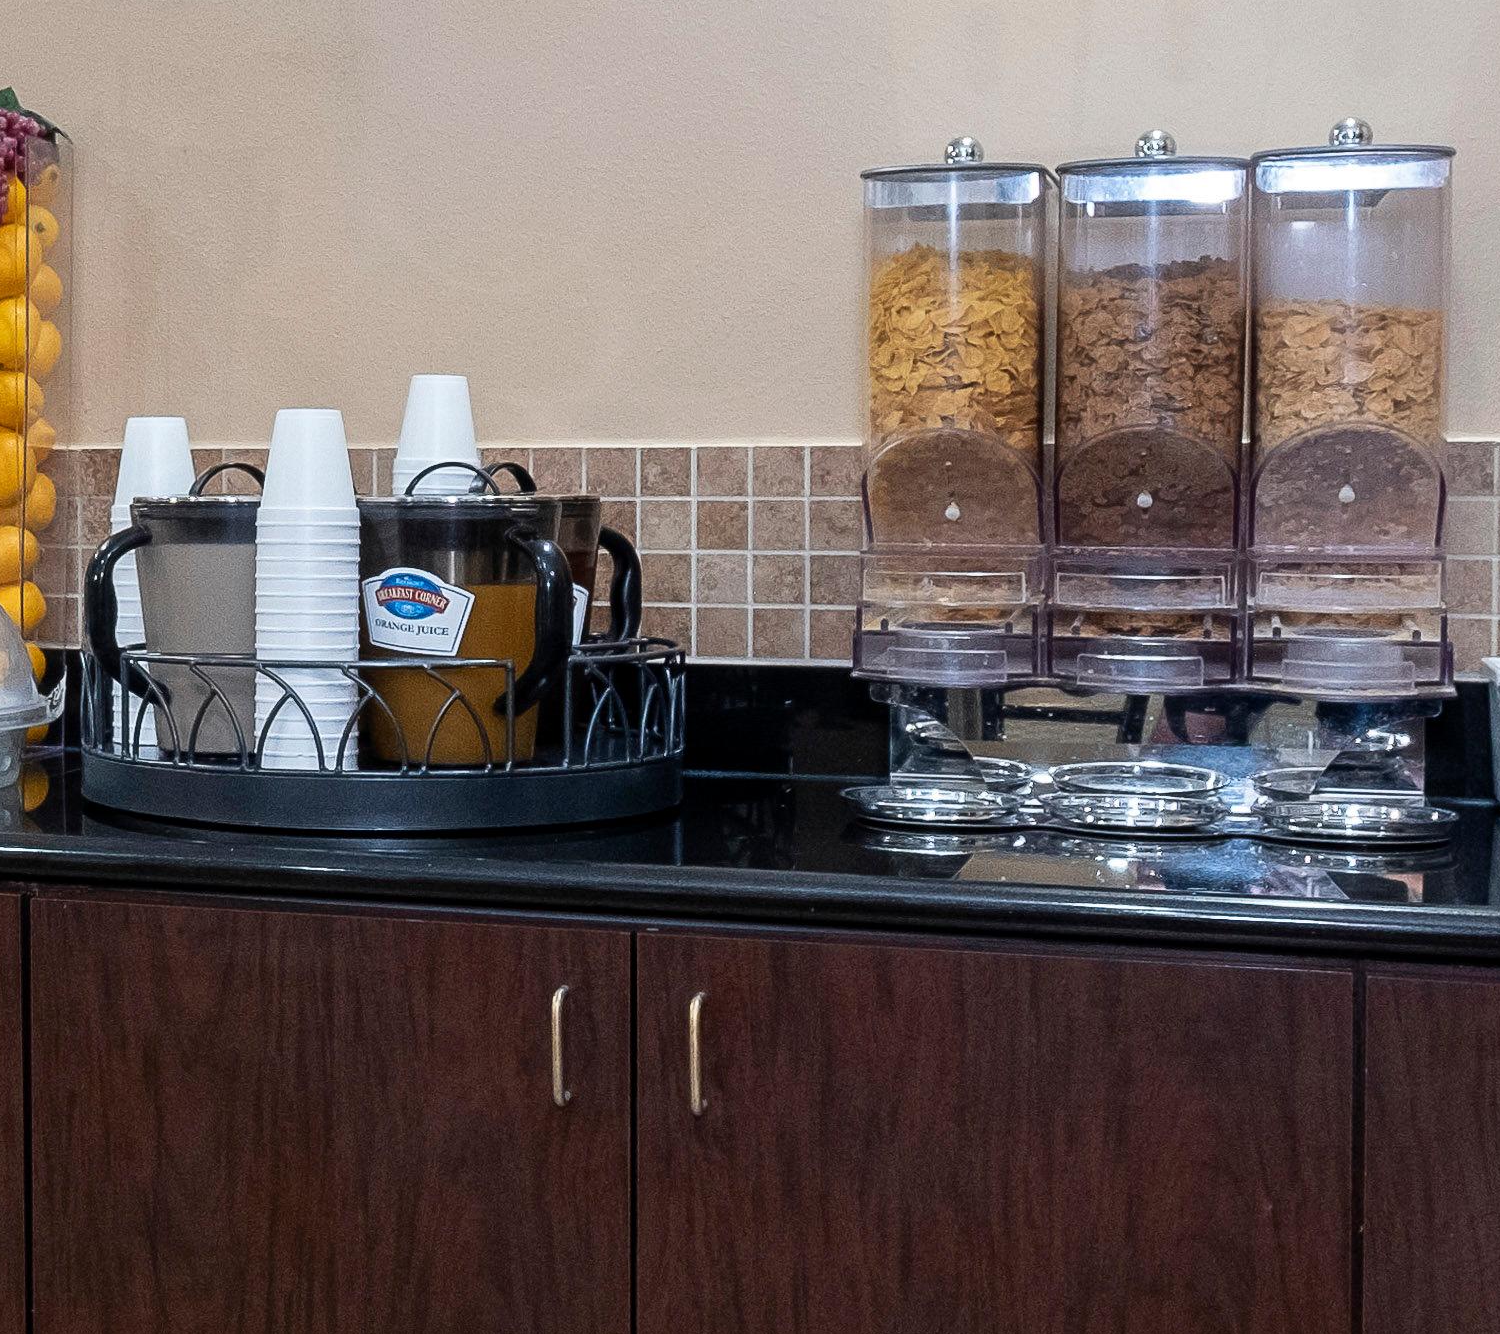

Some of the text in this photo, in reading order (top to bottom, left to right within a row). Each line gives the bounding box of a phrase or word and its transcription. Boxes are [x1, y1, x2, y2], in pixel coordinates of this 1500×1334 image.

[377, 587, 447, 609] BREAKFAST CORNER
[375, 618, 449, 636] ORANGE JUICE
